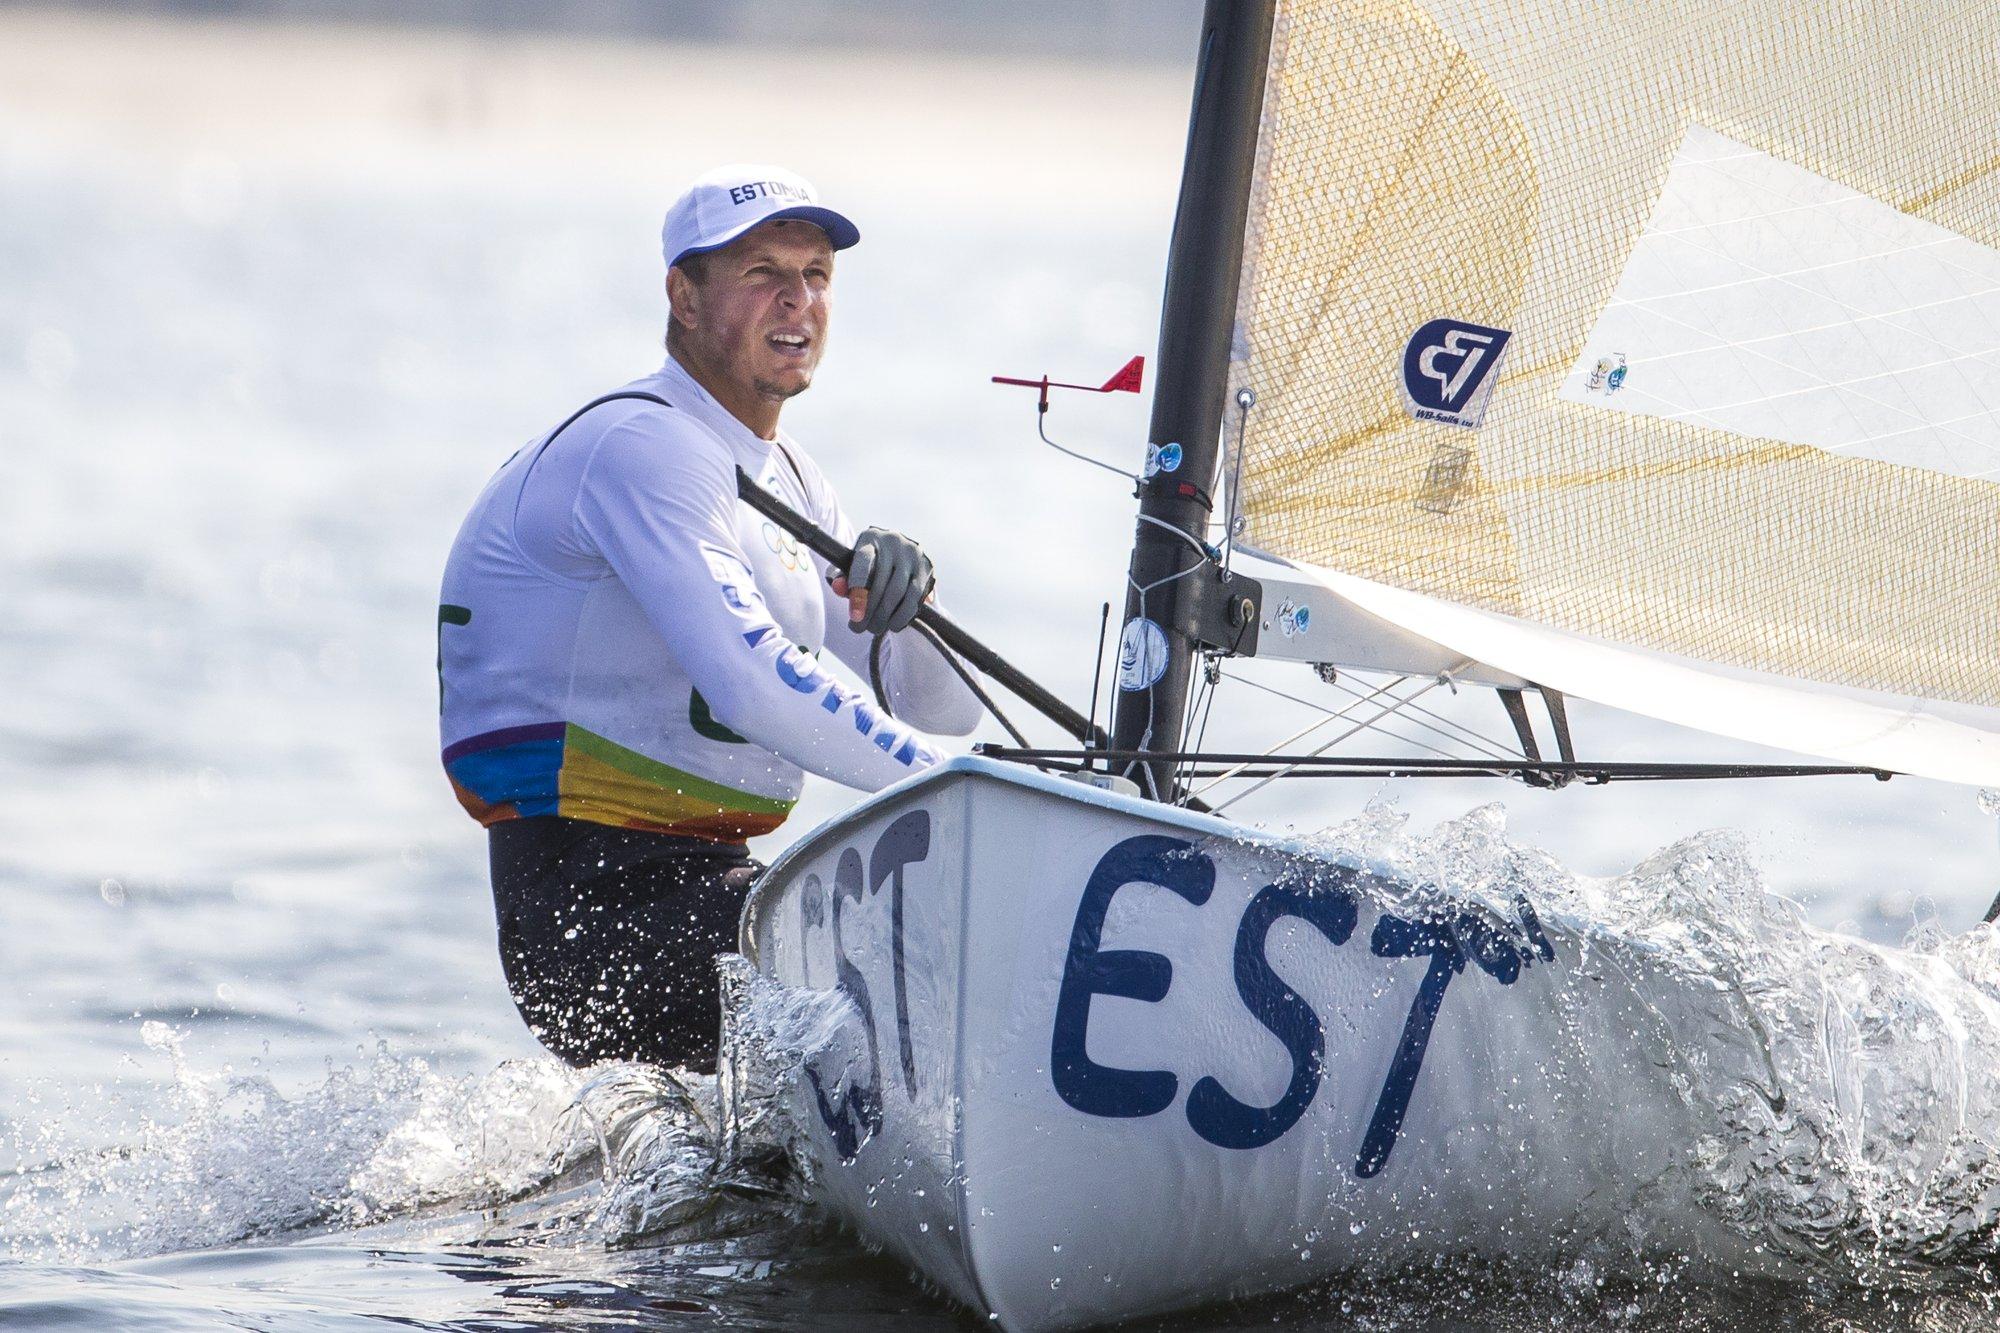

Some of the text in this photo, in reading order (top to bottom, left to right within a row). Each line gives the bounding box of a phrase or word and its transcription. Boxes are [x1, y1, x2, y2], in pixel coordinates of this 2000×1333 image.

[729, 181, 811, 205] ESTONIA
[1416, 410, 1459, 424] WB-Sails
[1051, 834, 1555, 1178] EST
